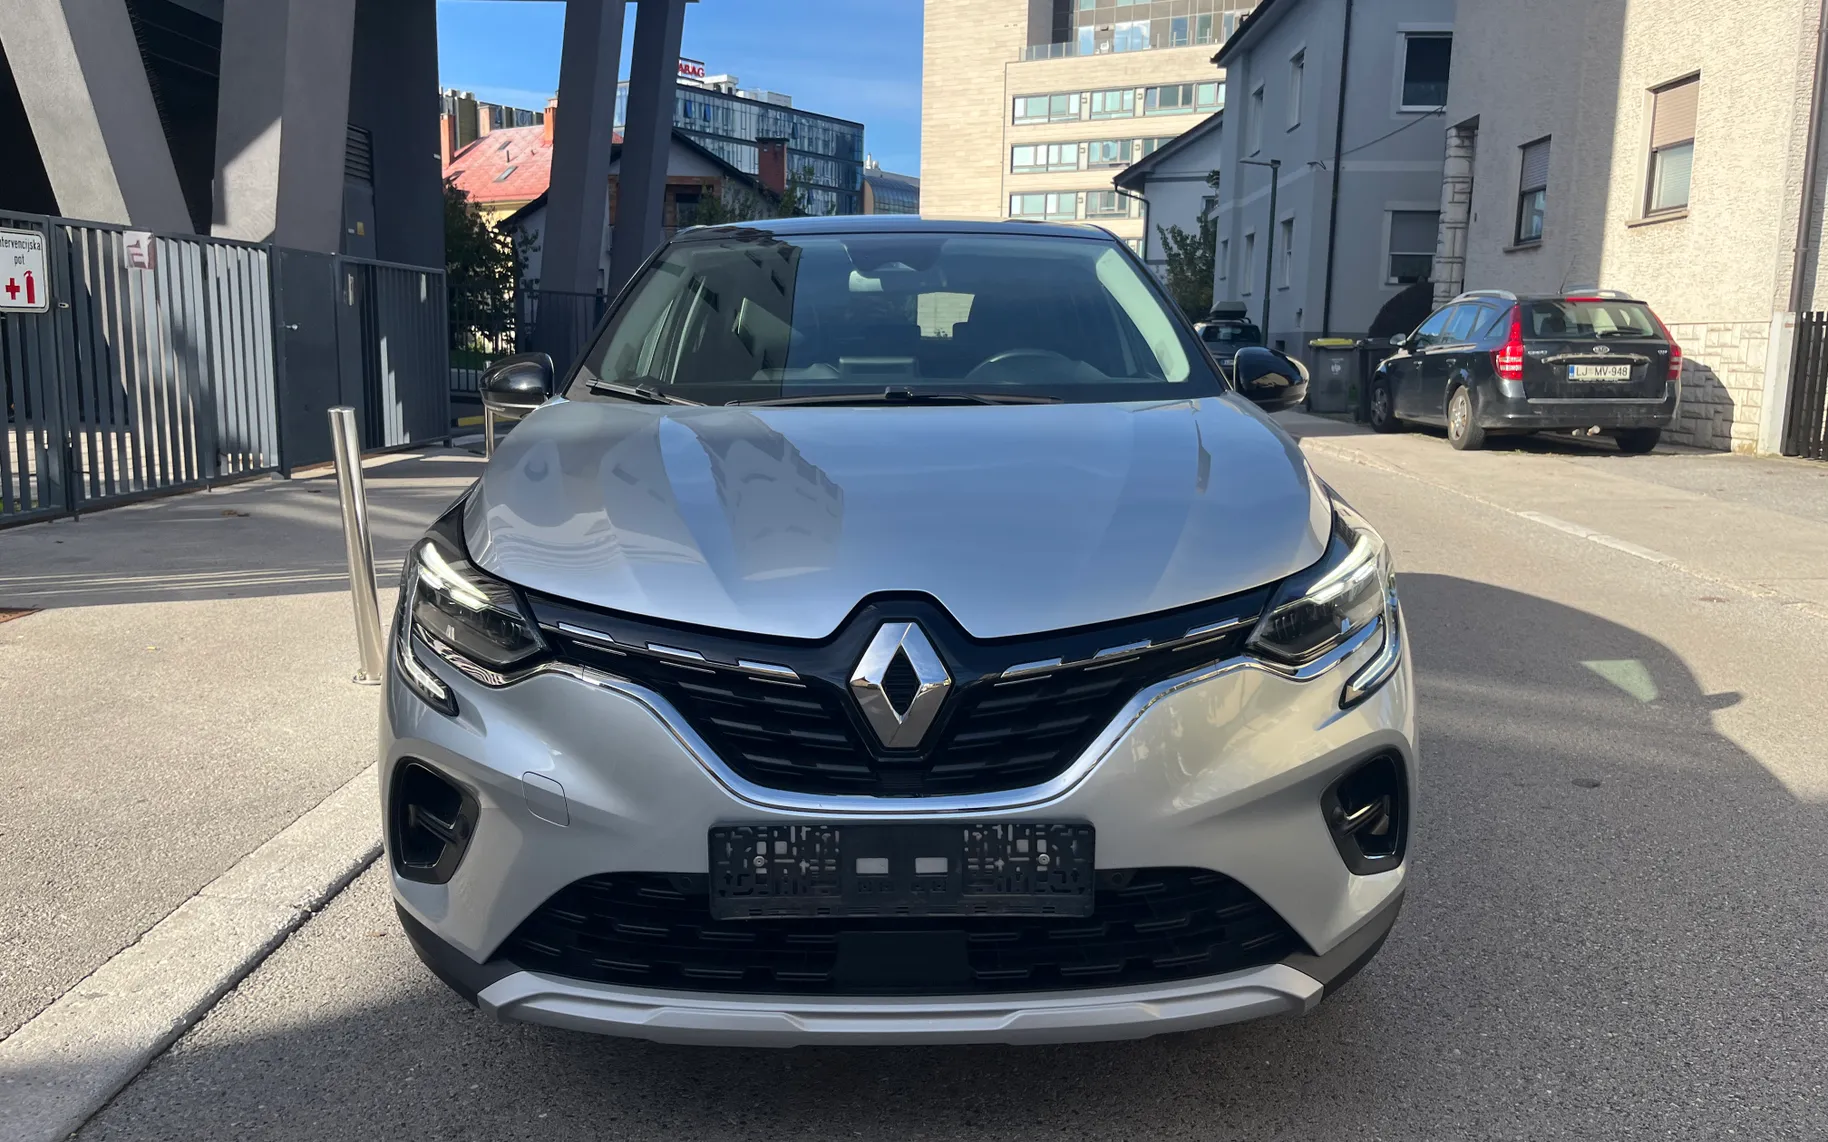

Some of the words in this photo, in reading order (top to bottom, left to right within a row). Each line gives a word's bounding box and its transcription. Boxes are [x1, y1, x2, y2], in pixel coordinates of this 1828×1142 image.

[14, 254, 25, 267] pot
[1576, 367, 1588, 376] LJ
[1594, 367, 1628, 376] MV-948
